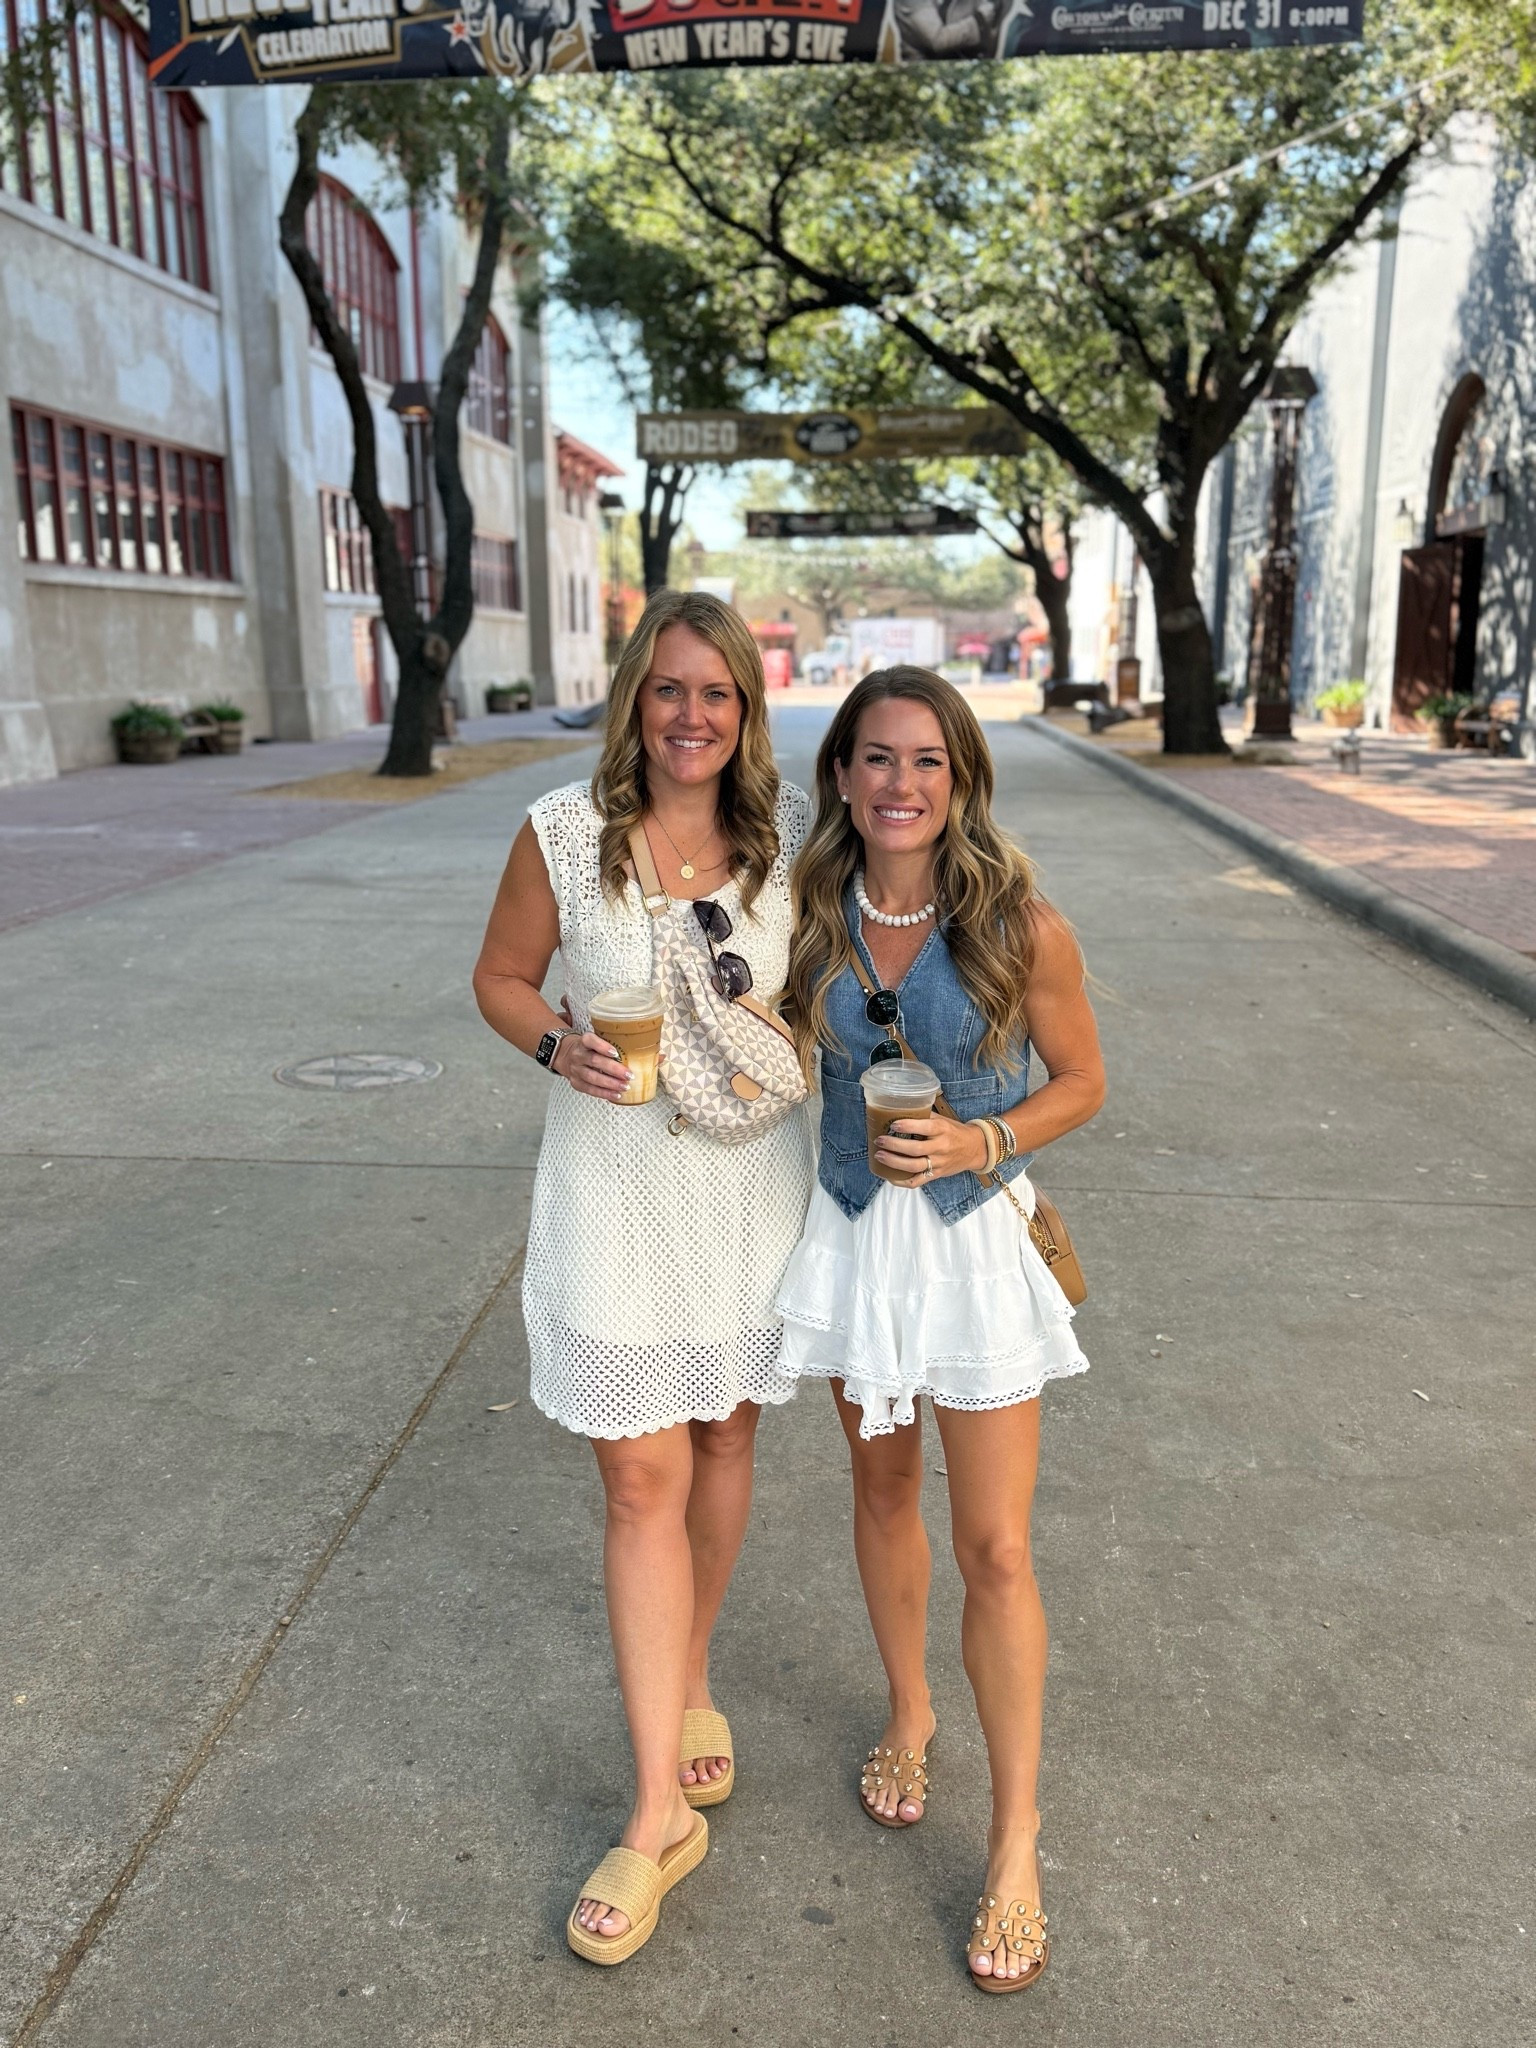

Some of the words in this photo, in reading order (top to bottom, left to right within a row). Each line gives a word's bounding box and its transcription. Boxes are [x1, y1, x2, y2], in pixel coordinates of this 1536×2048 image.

[1202, 0, 1247, 31] DEC
[1255, 0, 1281, 29] 31
[1289, 6, 1349, 27] 8:00PM
[256, 20, 390, 67] CELEBRATION
[623, 25, 688, 69] NEW
[693, 18, 791, 60] YEAR'S
[796, 22, 848, 62] EVE
[643, 420, 738, 454] RODEO
